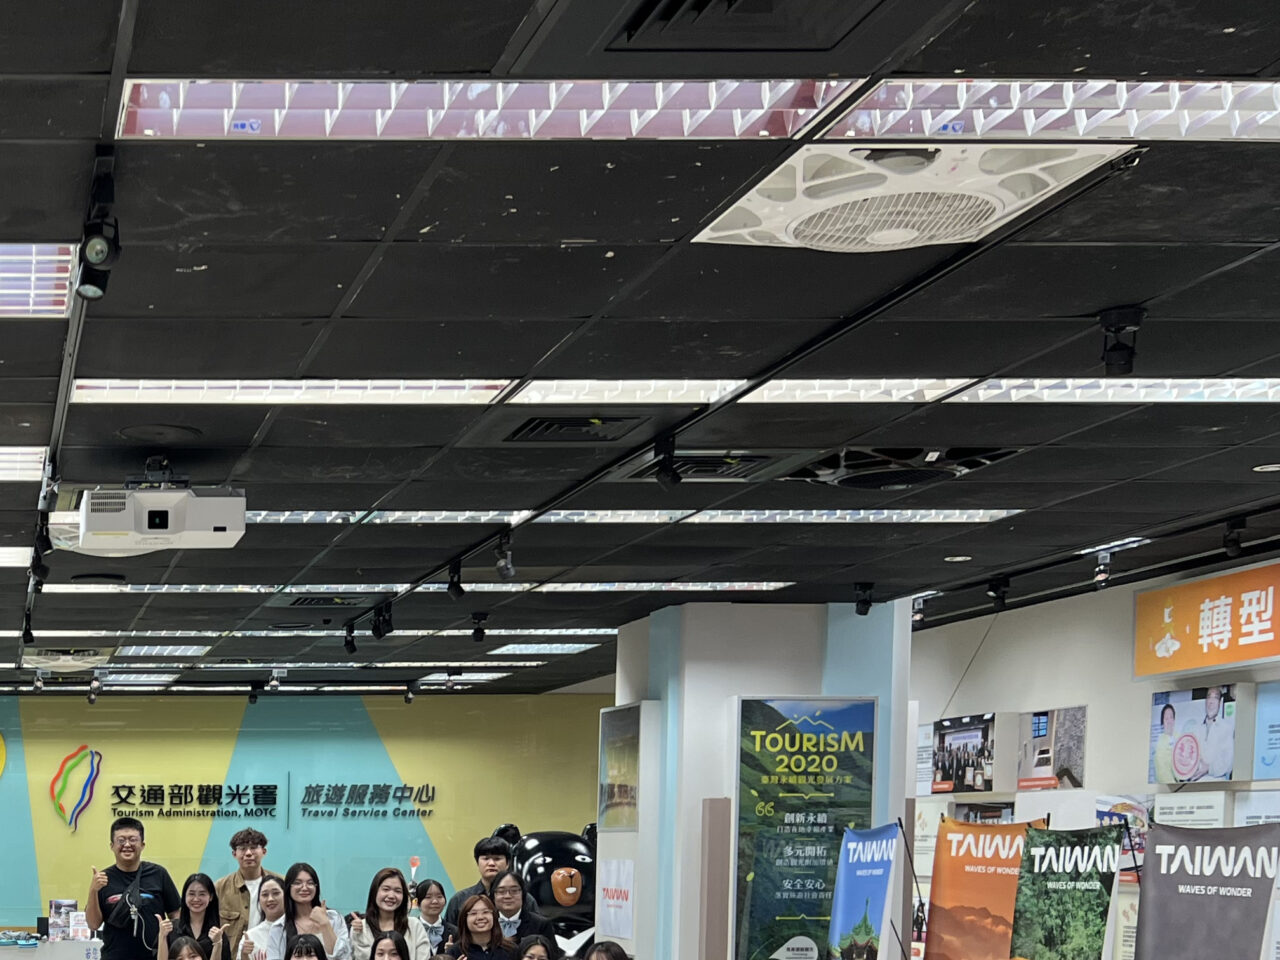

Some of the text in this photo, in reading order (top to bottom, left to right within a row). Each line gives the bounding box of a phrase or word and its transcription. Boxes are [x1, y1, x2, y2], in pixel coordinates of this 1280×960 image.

[1198, 586, 1274, 653] 轉型
[750, 731, 864, 752] TOURISM
[776, 755, 838, 772] 2020
[111, 784, 278, 806] 交通部觀光署
[301, 784, 436, 804] 旅遊服務中心
[111, 808, 277, 819] Tourism Administration, MOTC
[301, 808, 434, 817] Travel Service Center
[784, 813, 827, 824] 創新永續
[783, 846, 827, 857] 多元開拓
[847, 838, 896, 864] TAIWAN
[947, 833, 1025, 860] TAIWA
[1031, 844, 1120, 873] TAIWAN
[1155, 845, 1278, 879] TAIWAN
[965, 865, 986, 873] WAVES
[997, 867, 1020, 875] WONDE
[782, 879, 825, 890] 安全安心
[1047, 881, 1067, 889] WAVES
[1075, 882, 1101, 890] WONDER
[1178, 885, 1252, 897] WAVES OF WONDER
[602, 887, 629, 902] TAIWAN
